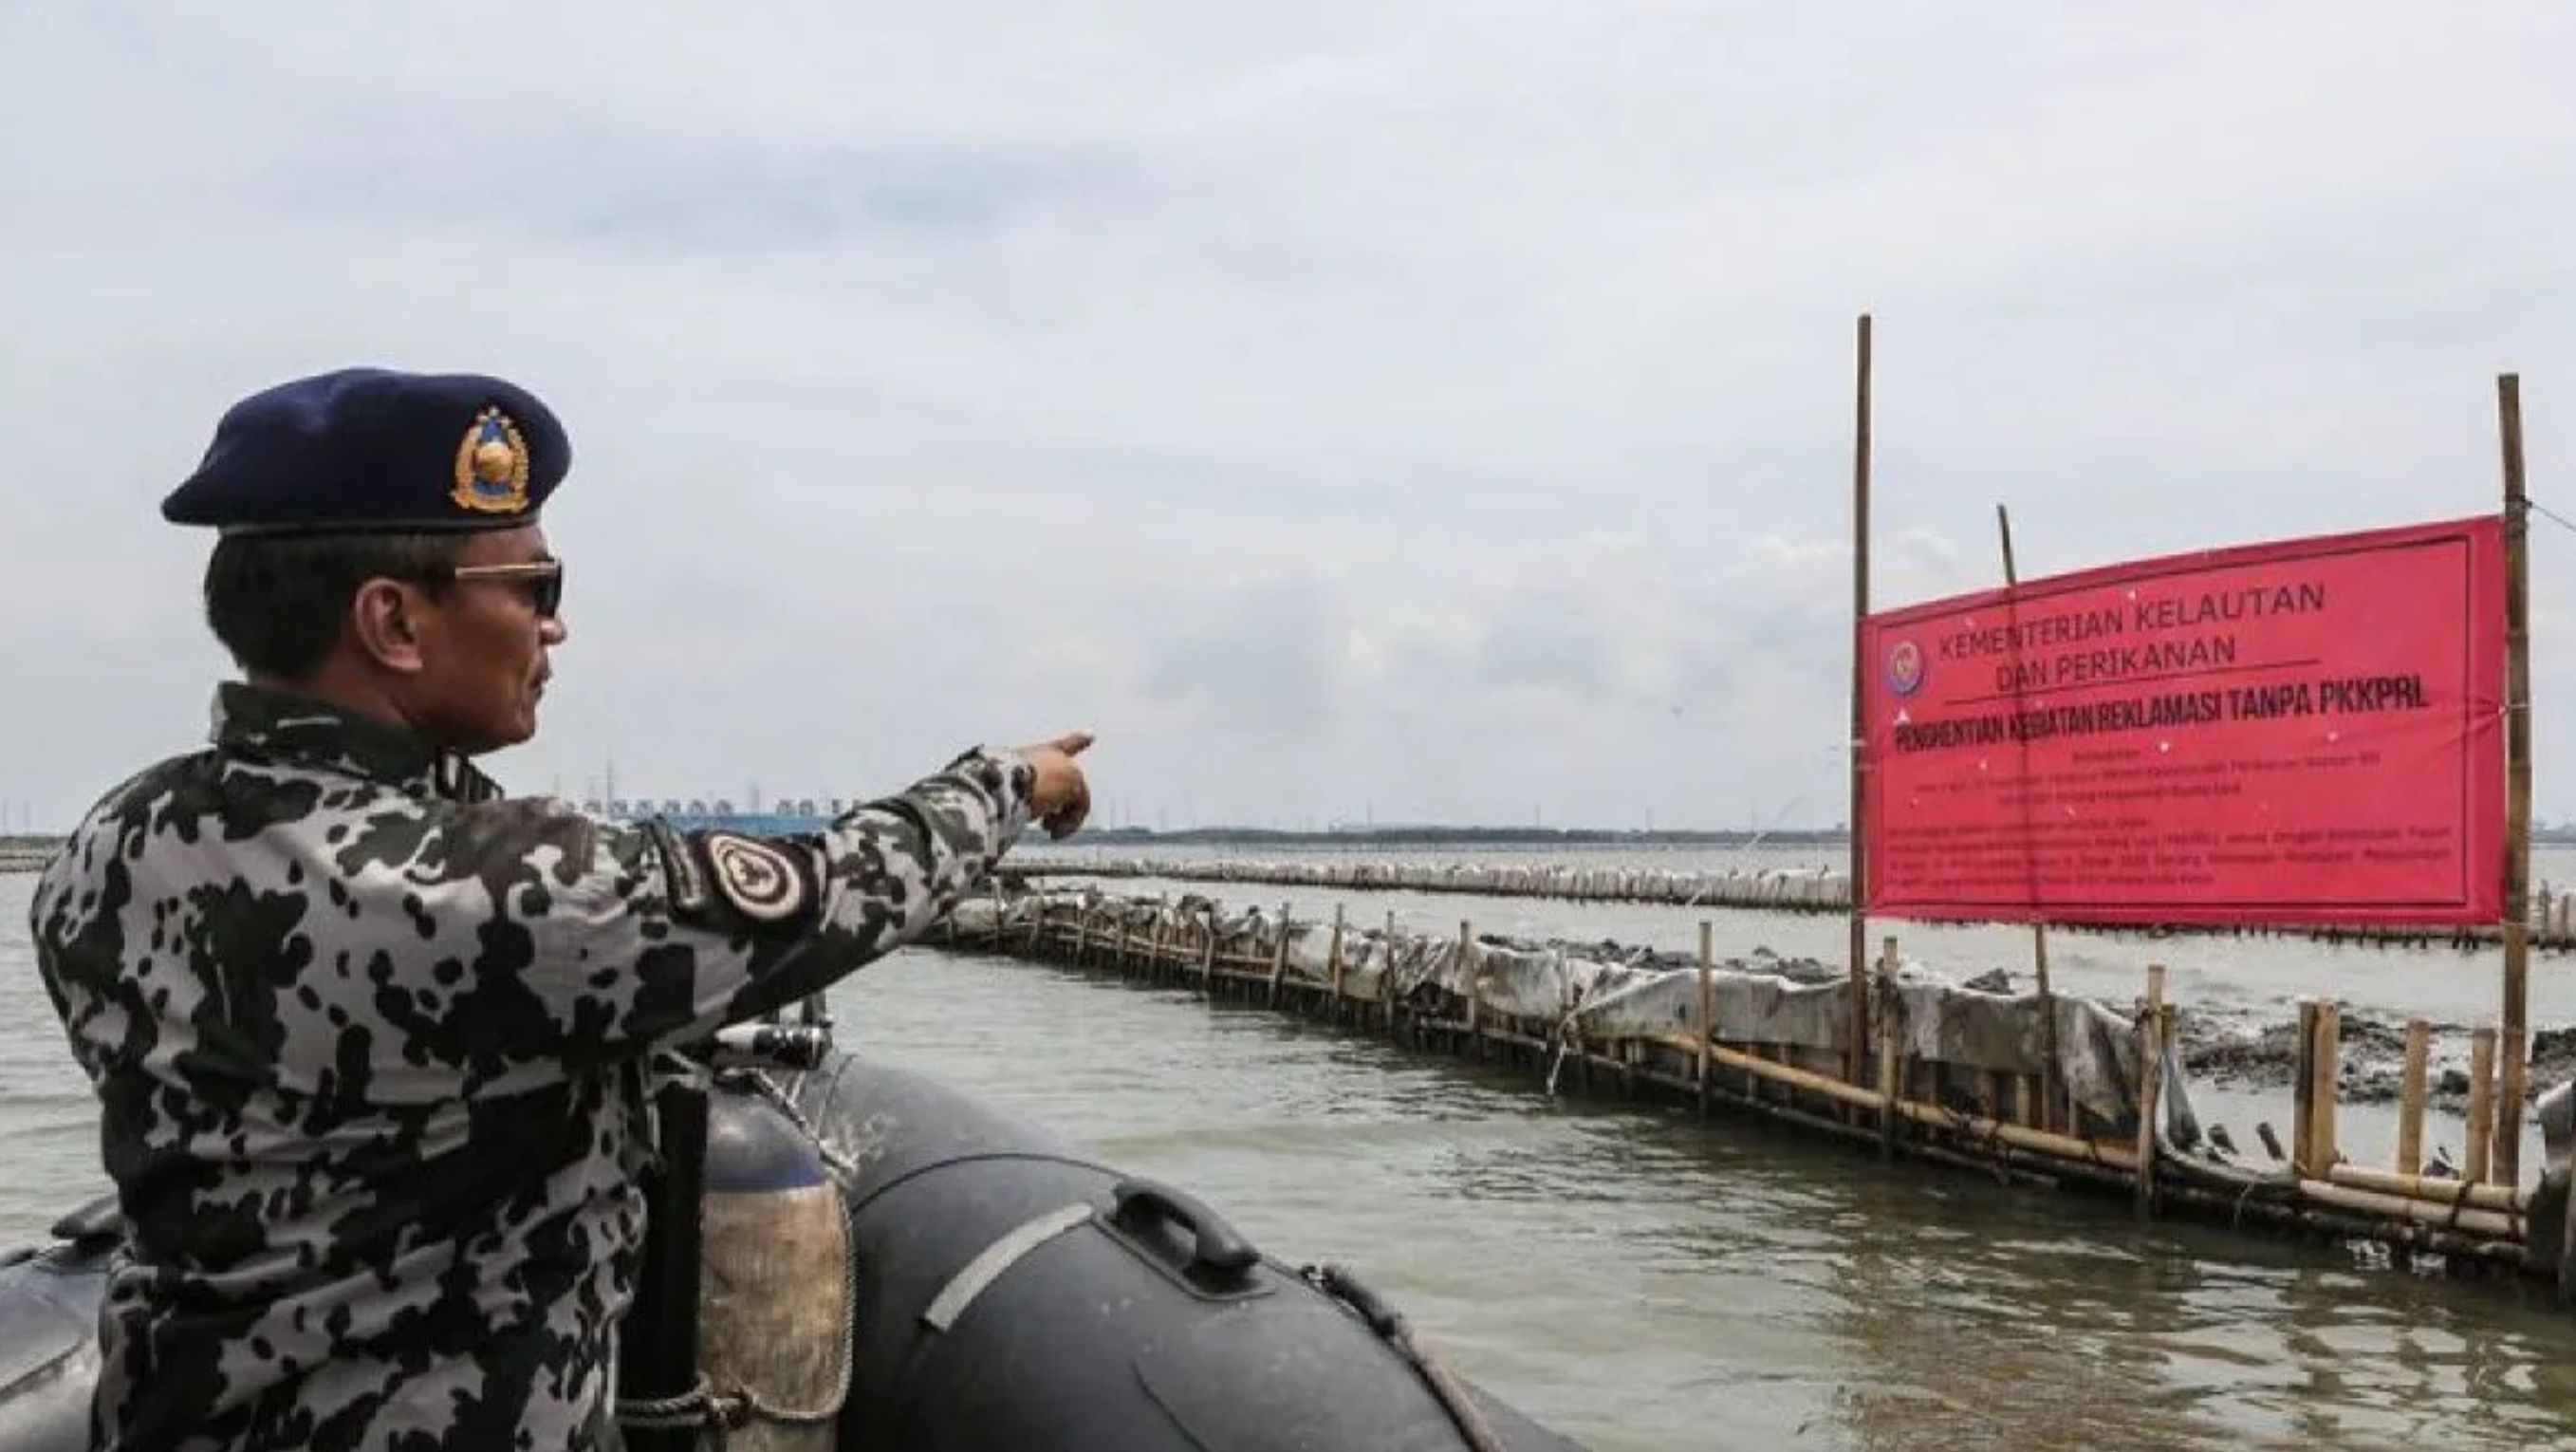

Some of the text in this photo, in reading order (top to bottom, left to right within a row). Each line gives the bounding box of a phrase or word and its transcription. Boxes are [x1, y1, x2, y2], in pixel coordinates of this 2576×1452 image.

[1939, 580, 2325, 660] KEMENTERIAN KELAUTAN
[1996, 634, 2236, 692] DAN PERIKANAN
[1895, 714, 2005, 753] PENGHENTIAN
[2097, 690, 2222, 735] REKLAMASI
[2227, 682, 2313, 721] TANPA
[2319, 673, 2431, 714] PKKPRL
